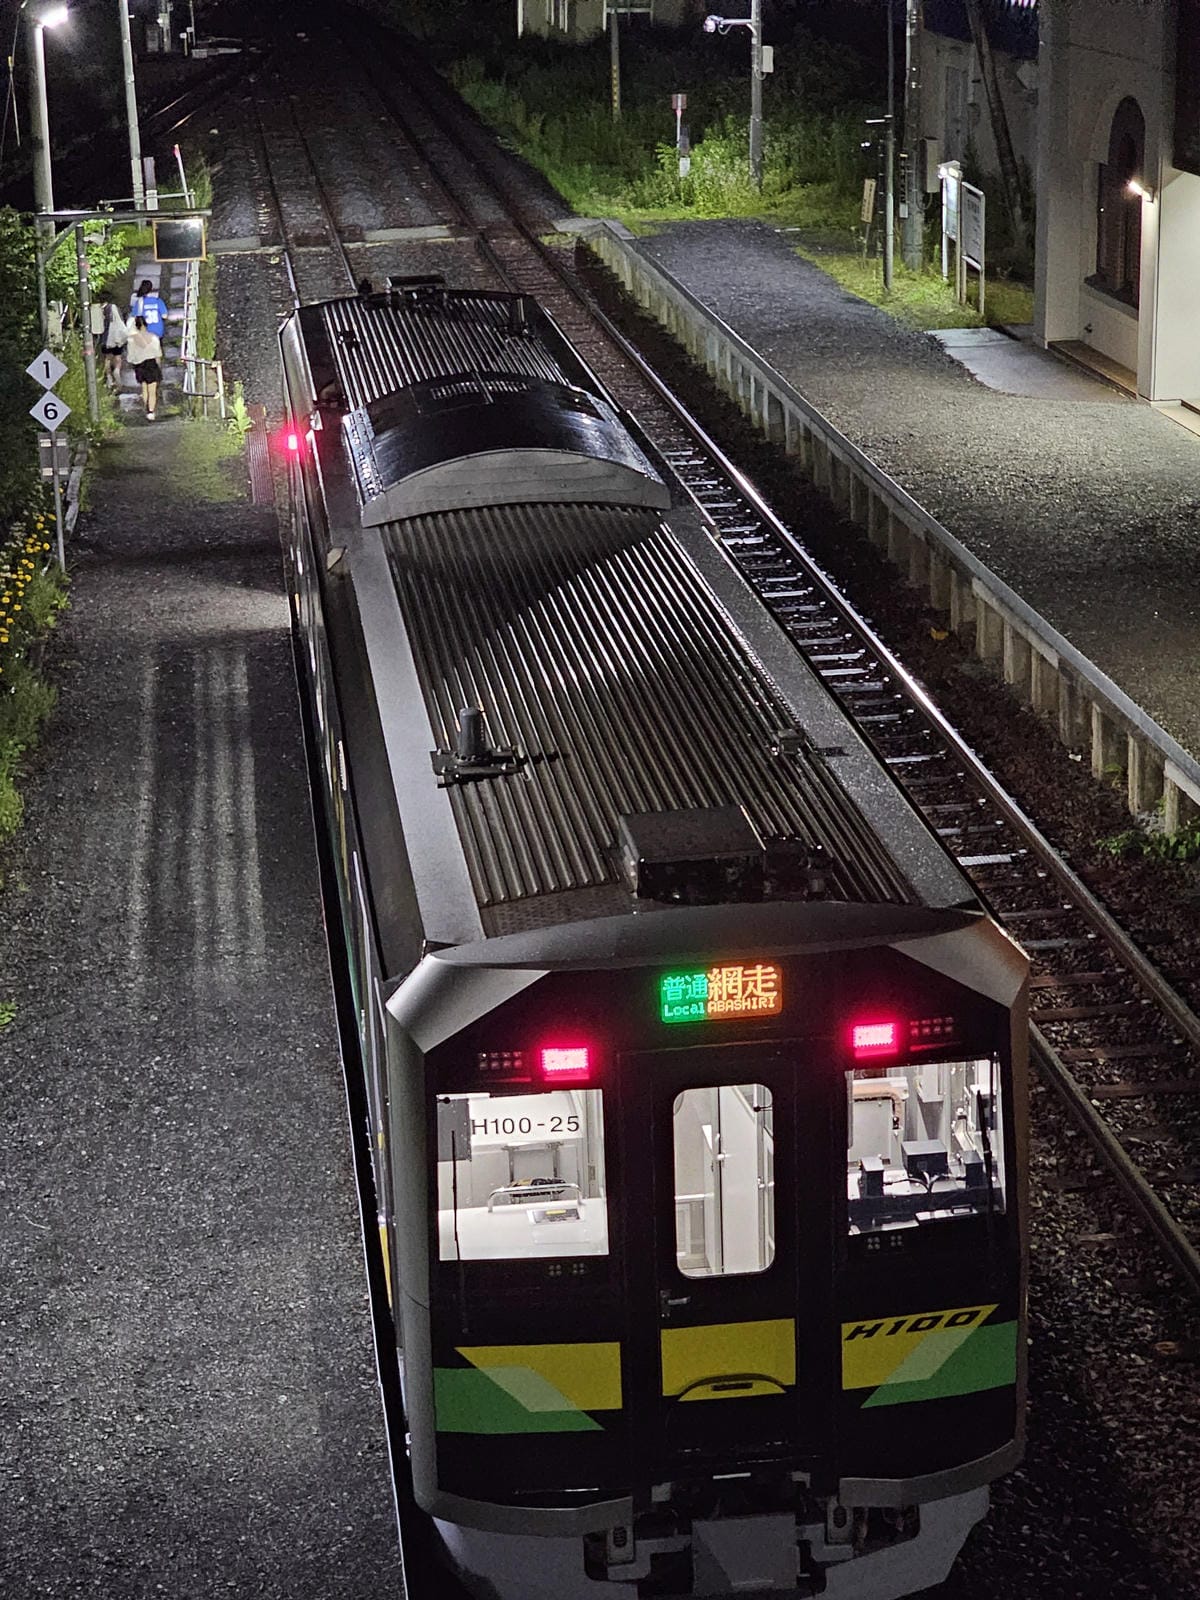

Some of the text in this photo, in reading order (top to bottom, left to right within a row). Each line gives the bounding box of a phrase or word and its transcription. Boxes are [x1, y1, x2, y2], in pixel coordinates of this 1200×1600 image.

[43, 361, 50, 379] 1
[43, 403, 58, 420] 6
[663, 964, 778, 1001] 普通 網走
[664, 996, 776, 1017] Local ABASHIRI
[845, 1310, 982, 1341] H100
